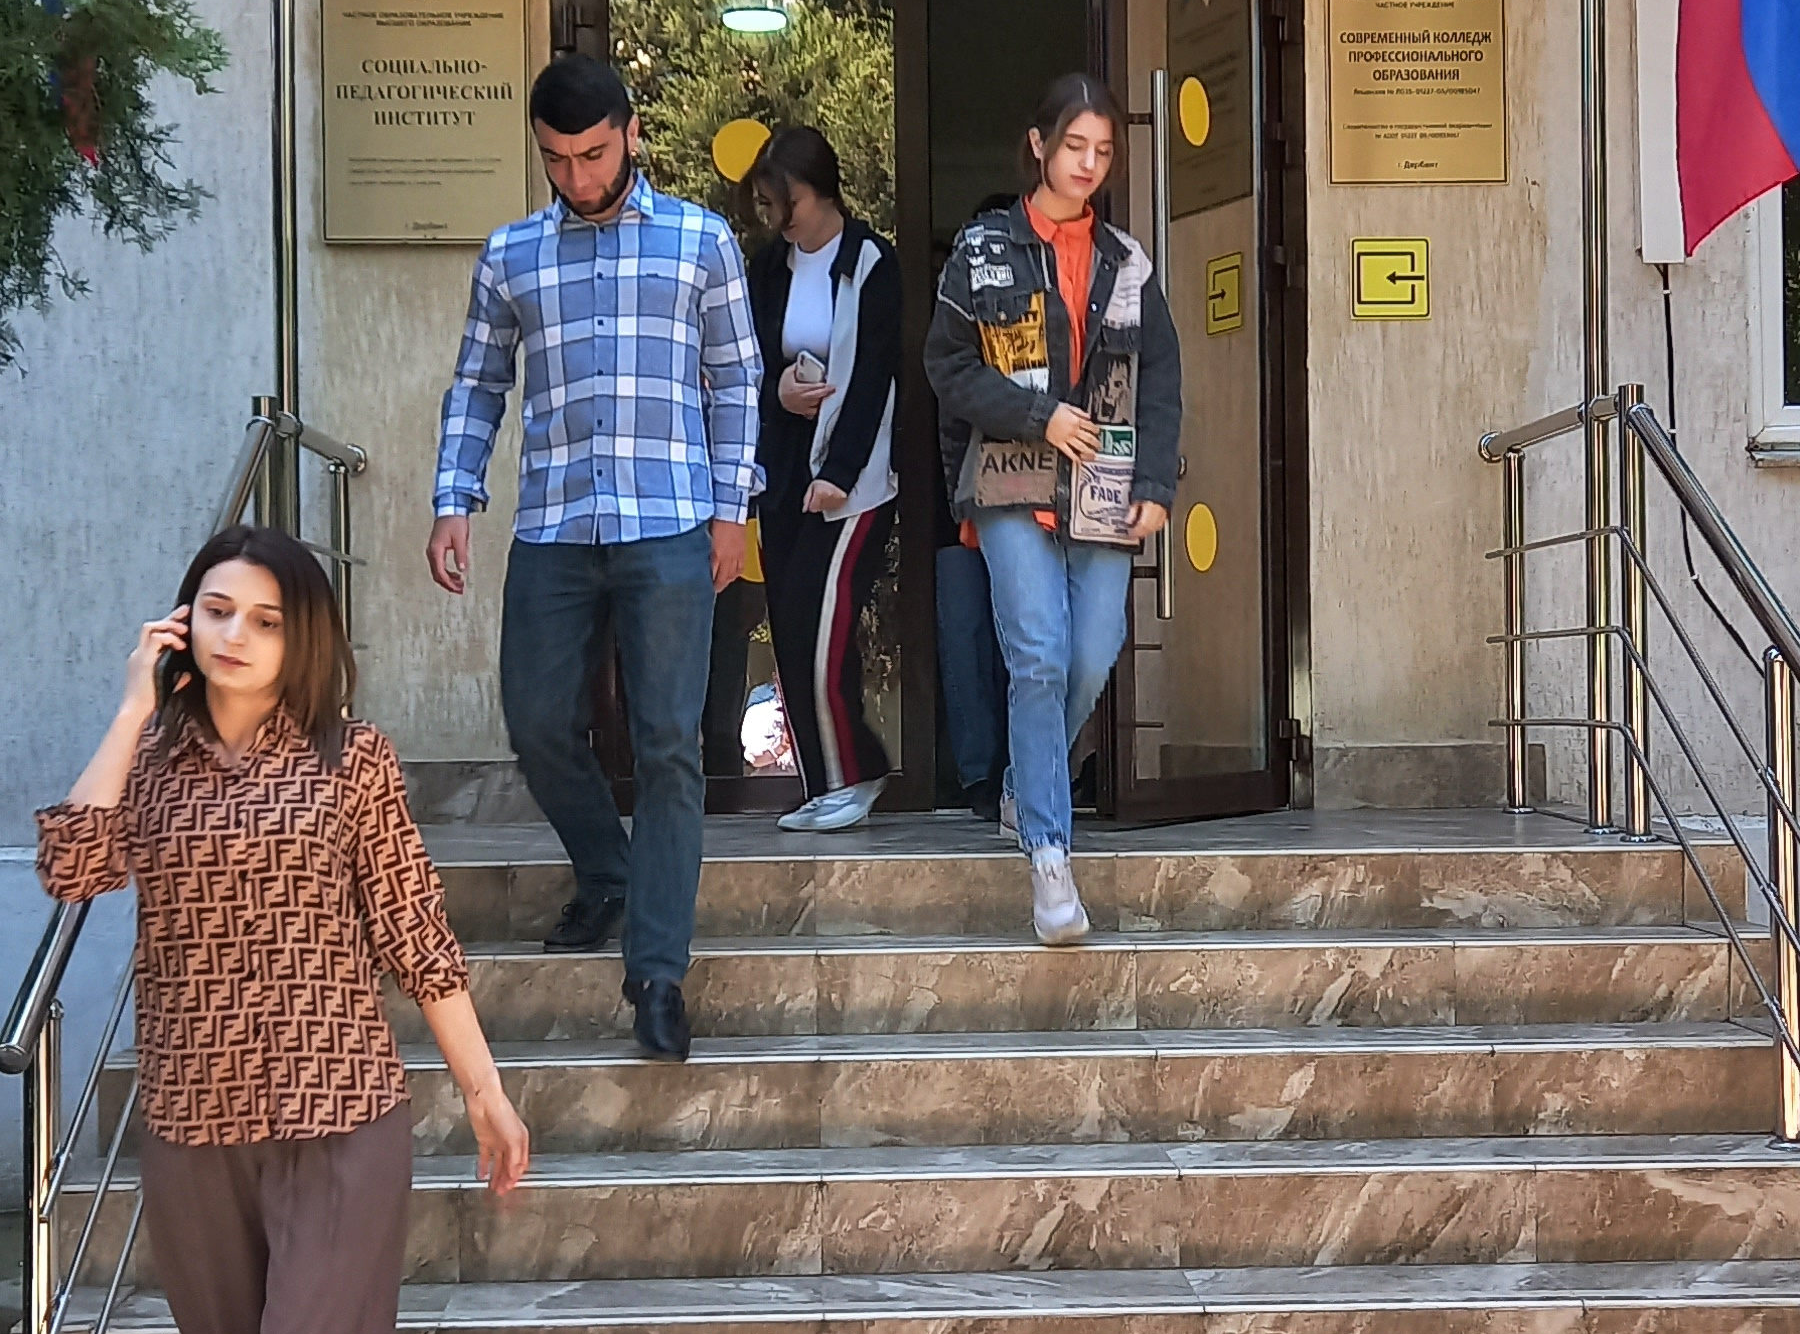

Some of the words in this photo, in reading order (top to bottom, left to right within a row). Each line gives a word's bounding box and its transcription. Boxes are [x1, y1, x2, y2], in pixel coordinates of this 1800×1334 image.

[1339, 29, 1431, 44] СОВРЕМЕННЫЙ
[1433, 31, 1492, 46] КОЛЛЕДЖ
[1348, 49, 1484, 63] ПРОФЕССИОНАЛЬНОГО
[361, 58, 488, 77] СОЦИАЛЬНО-
[1372, 68, 1460, 81] ОБРАЗОВАНИЯ
[335, 81, 514, 101] ПЕДАГОГИЧЕСКИЙ
[373, 110, 476, 126] ИНСТИТУТ
[981, 451, 1054, 478] AKNE
[1090, 484, 1122, 504] FADE
